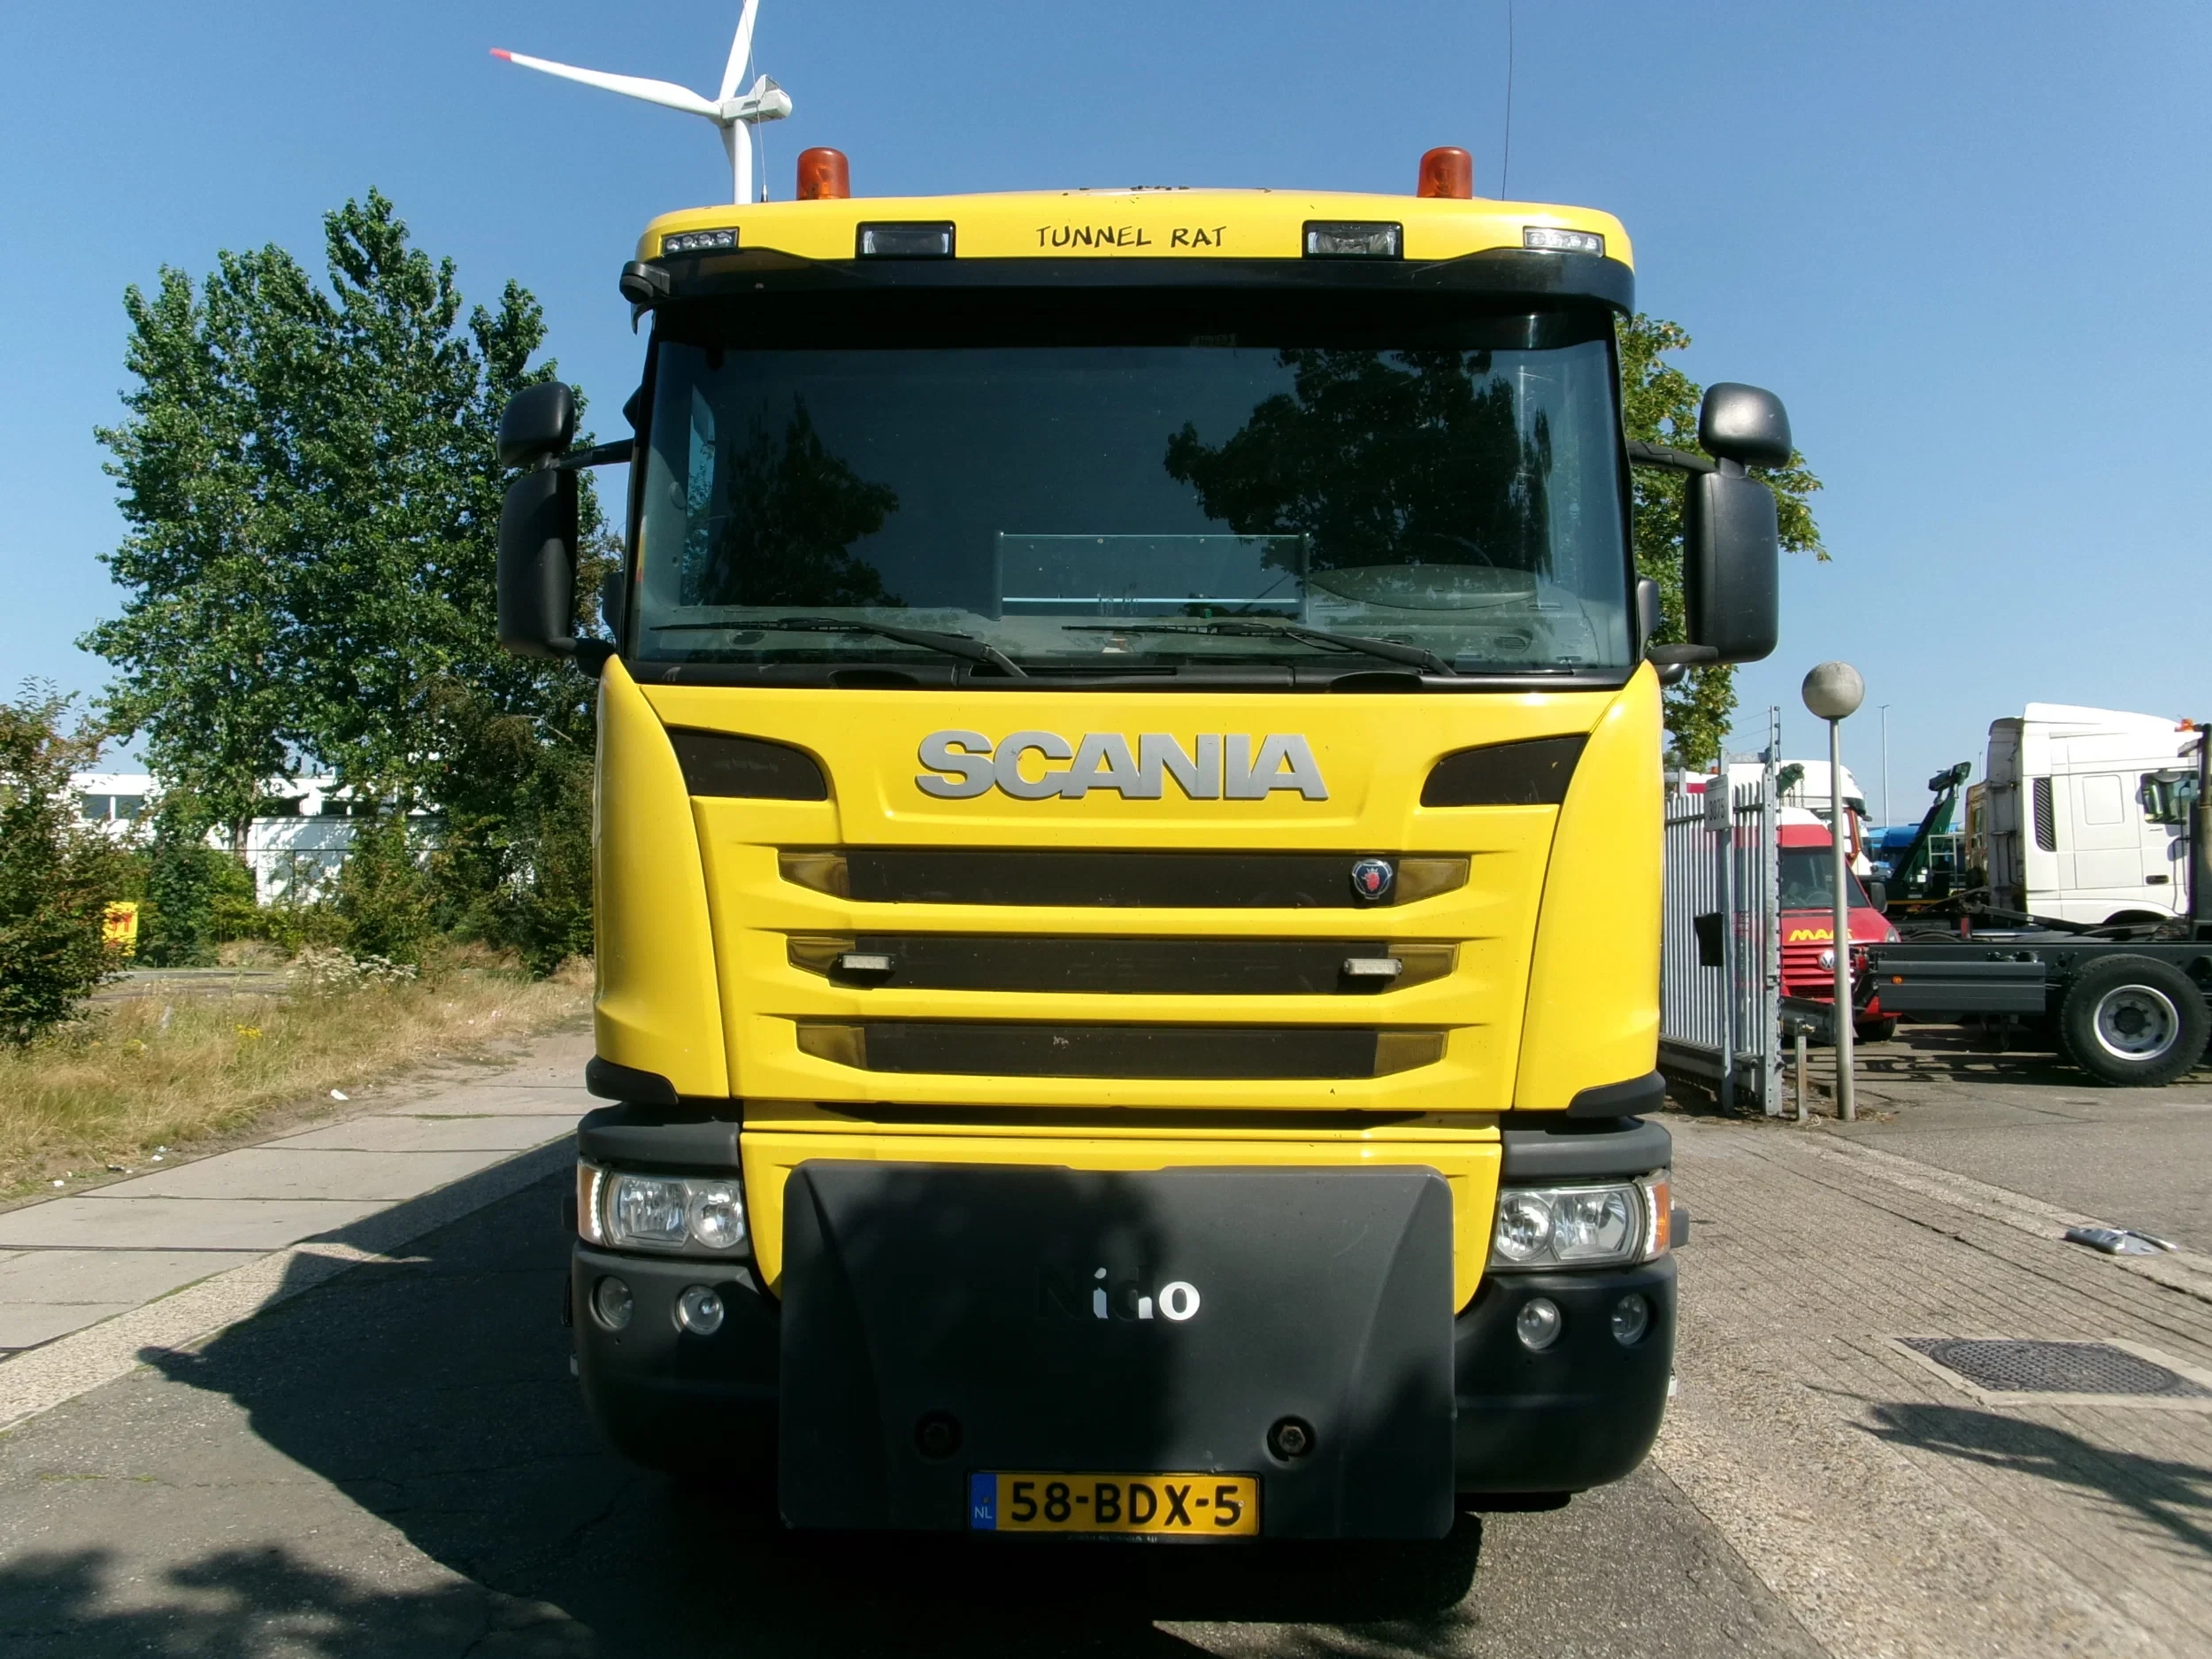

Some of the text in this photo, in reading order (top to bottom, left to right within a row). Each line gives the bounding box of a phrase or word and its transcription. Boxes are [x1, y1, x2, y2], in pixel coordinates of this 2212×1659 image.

[1036, 225, 1226, 248] TUNNEL RAT
[916, 730, 1329, 801] SCANIA
[974, 1506, 994, 1520] NL
[1010, 1481, 1243, 1526] 58-BDX-5
